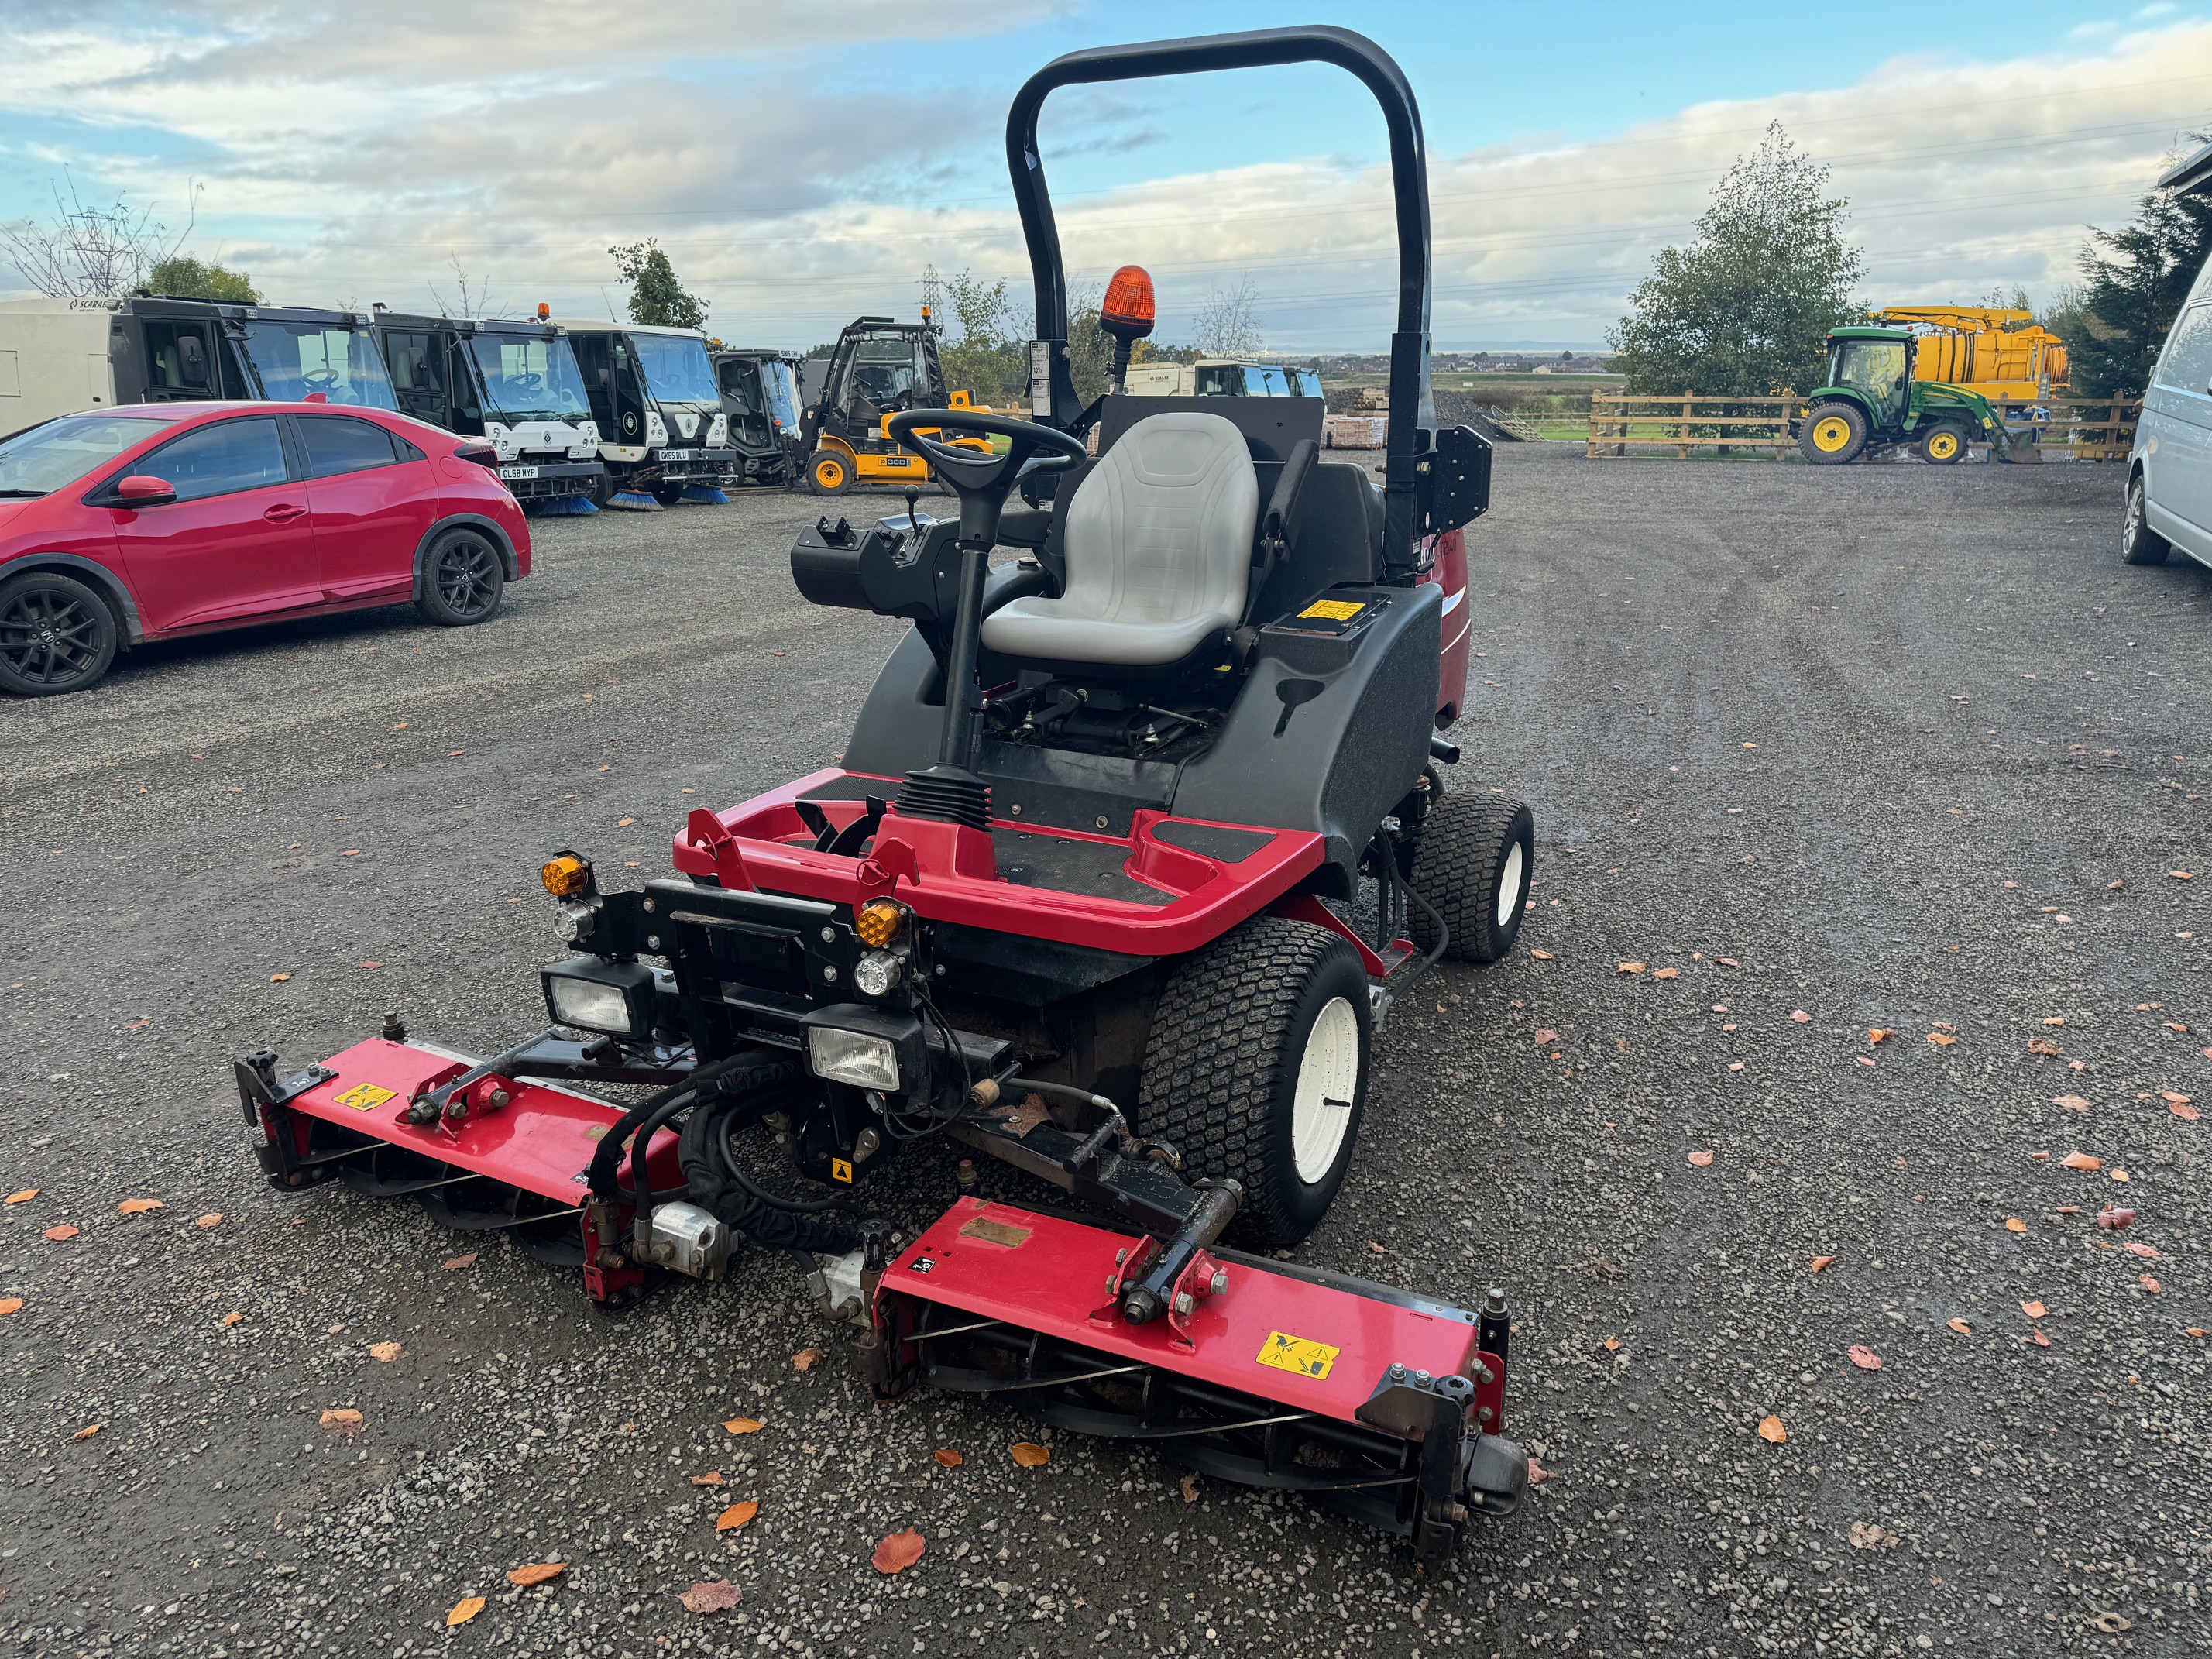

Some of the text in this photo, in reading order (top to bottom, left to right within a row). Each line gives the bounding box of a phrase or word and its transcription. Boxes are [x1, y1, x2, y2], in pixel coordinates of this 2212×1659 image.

[661, 451, 686, 460] GK65 DLU
[503, 468, 535, 479] GL68 MYP
